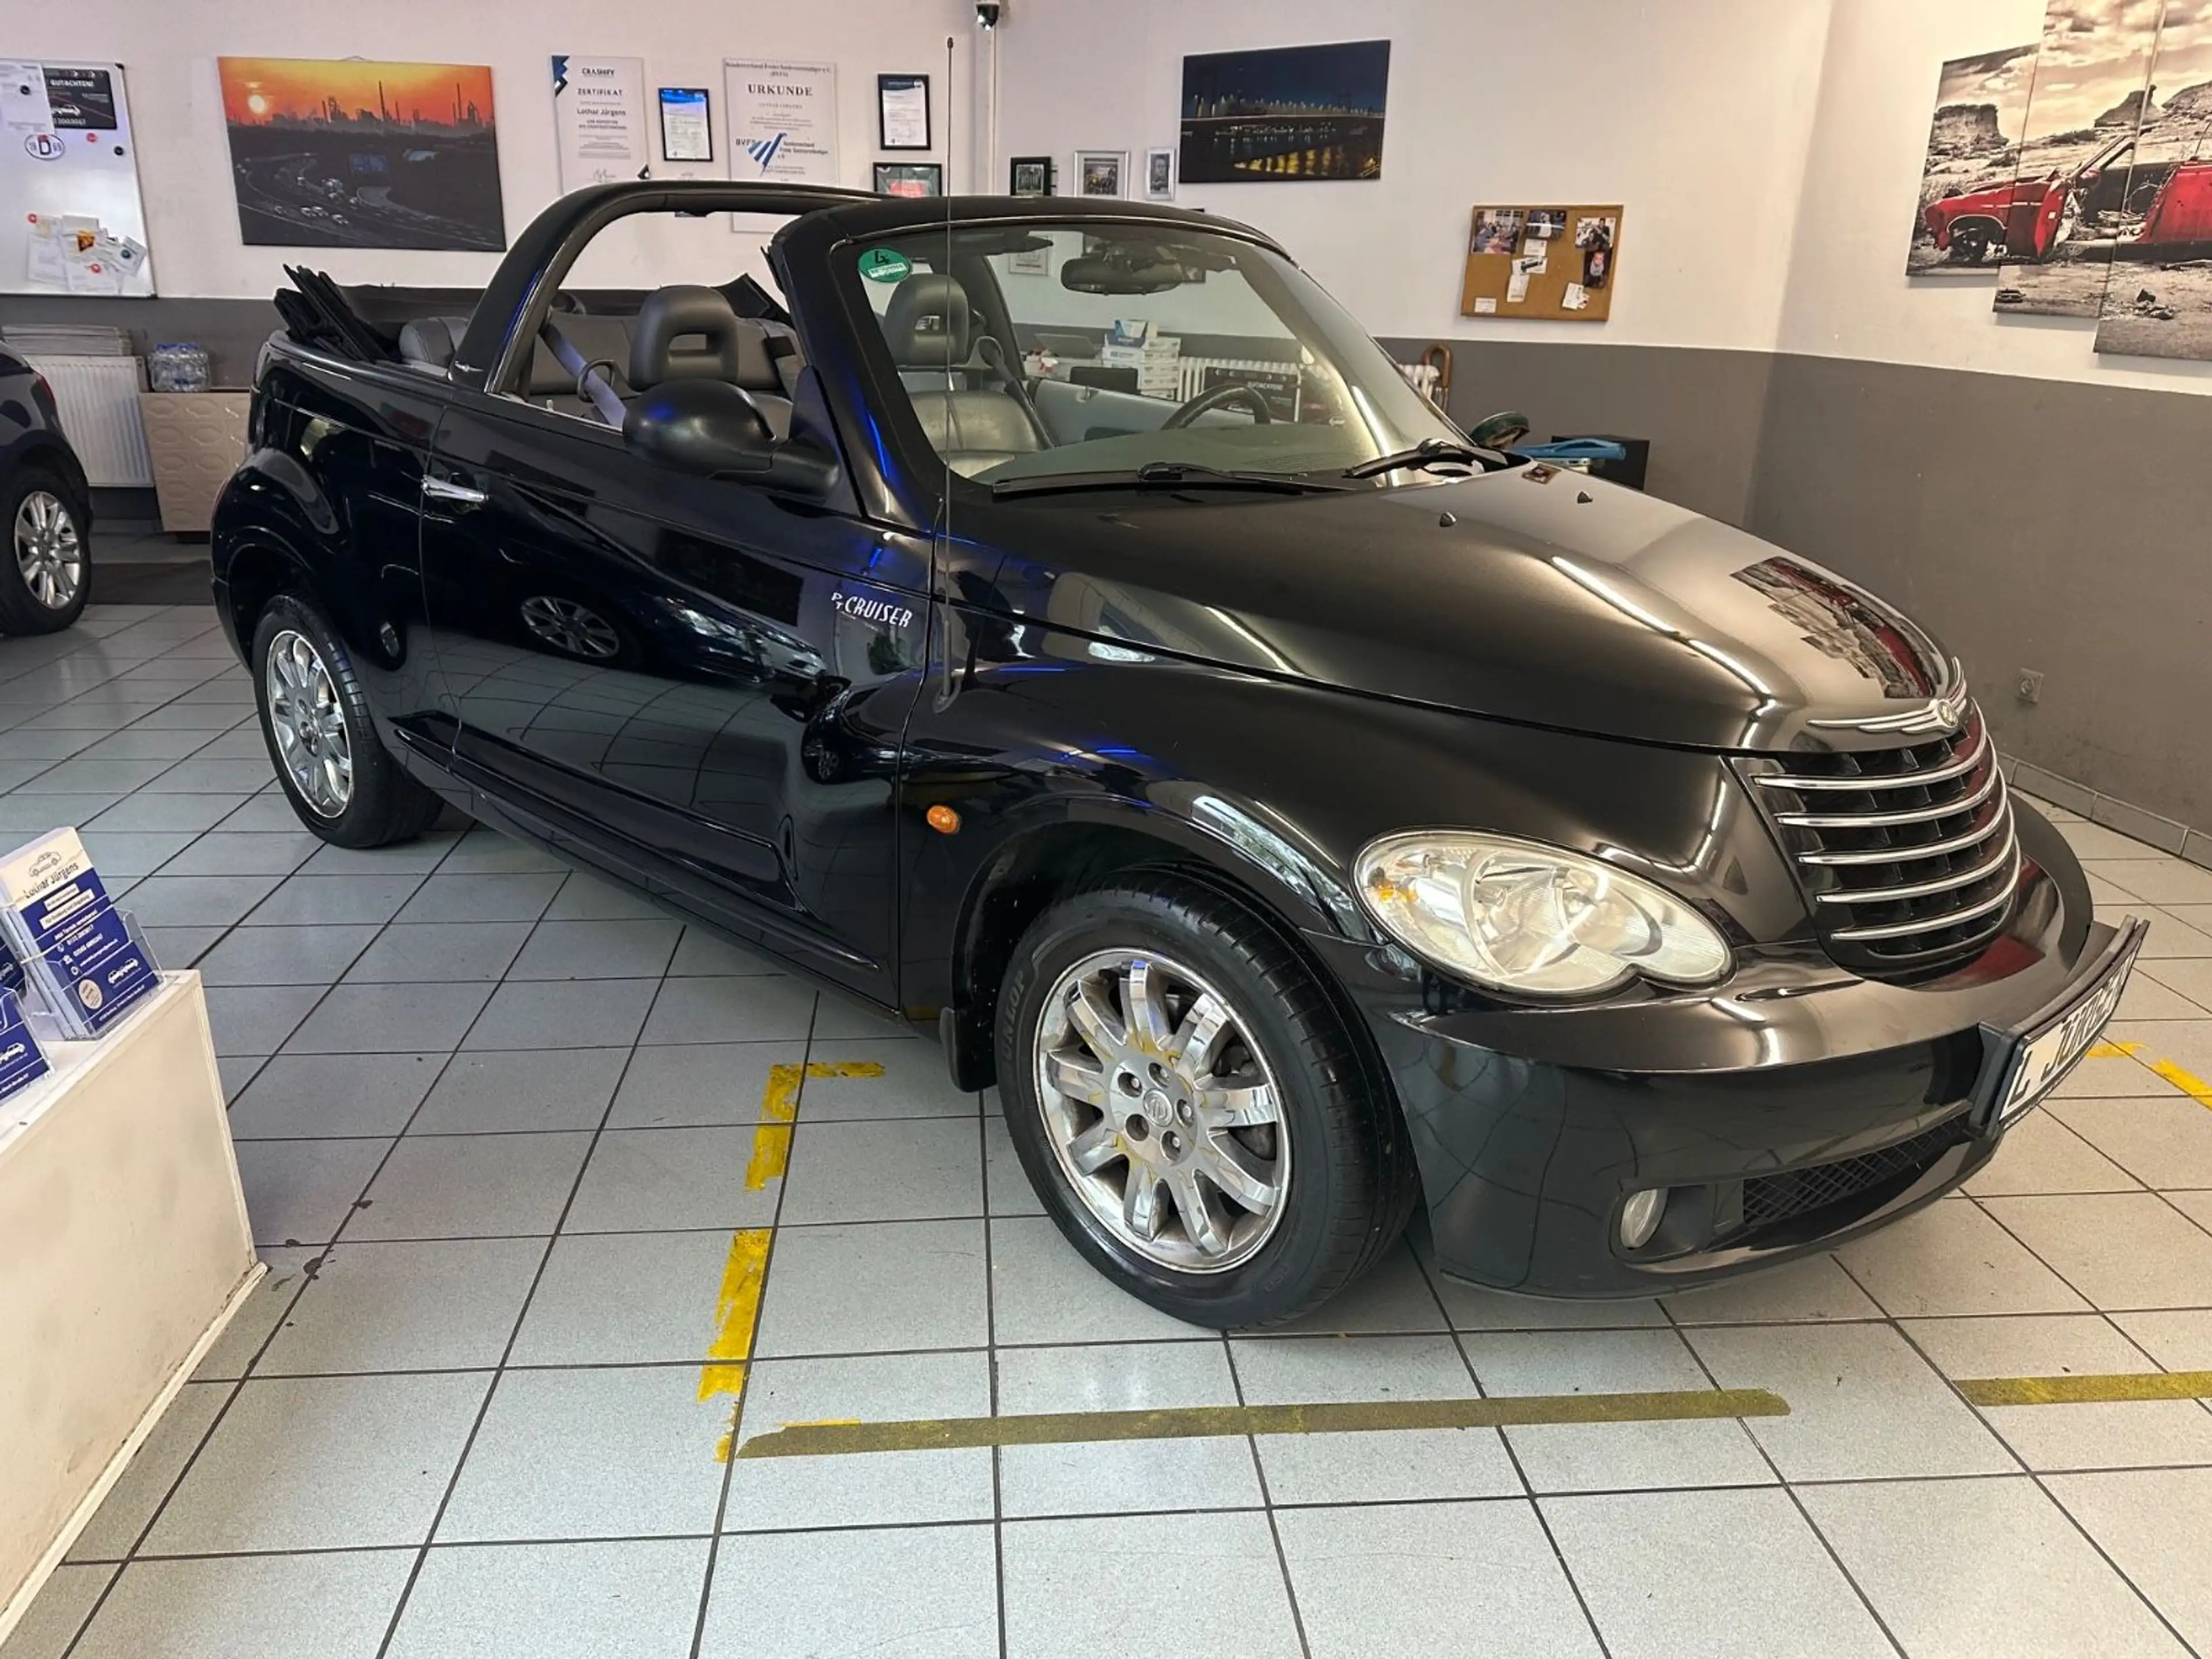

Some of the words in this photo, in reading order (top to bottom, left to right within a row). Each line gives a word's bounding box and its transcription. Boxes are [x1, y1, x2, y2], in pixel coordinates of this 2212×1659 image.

[577, 88, 623, 96] ZERTIFIKAT
[748, 84, 813, 96] URKUNDE
[844, 596, 913, 628] CRUISER
[1002, 969, 1025, 1075] UNLOP
